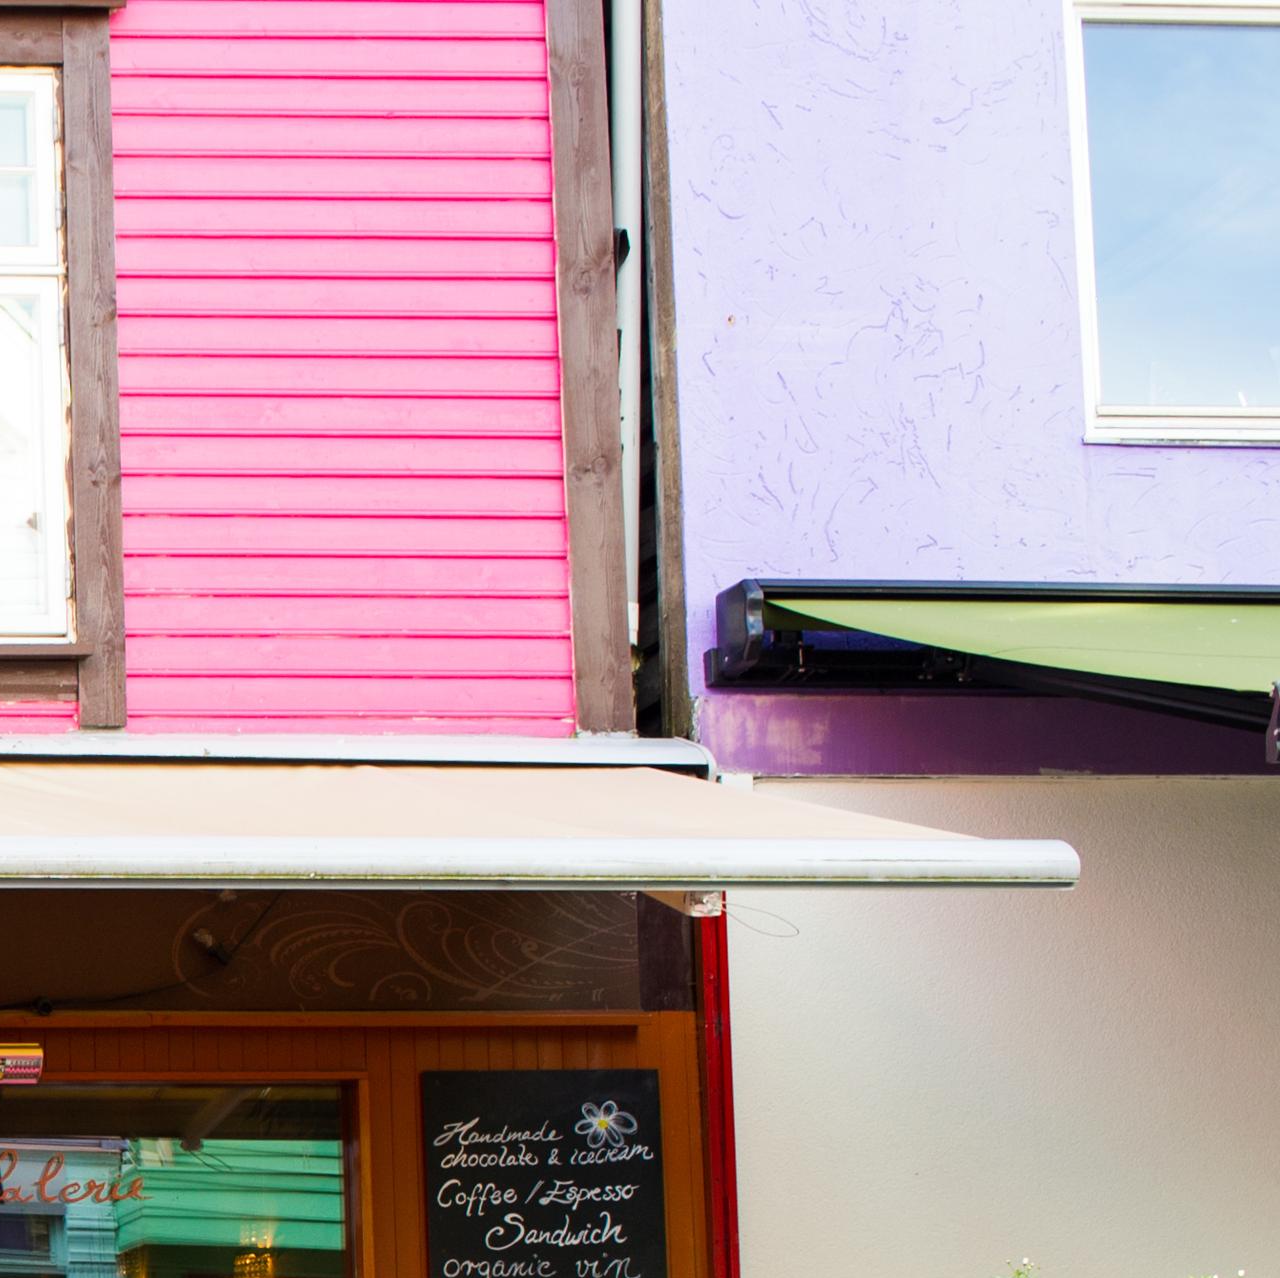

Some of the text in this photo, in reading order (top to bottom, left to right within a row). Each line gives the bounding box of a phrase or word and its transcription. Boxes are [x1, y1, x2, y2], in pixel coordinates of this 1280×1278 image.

[433, 1116, 564, 1147] Handmade
[440, 1143, 654, 1169] chocolate & icecream
[437, 1178, 517, 1217] Coffee
[538, 1179, 640, 1211] Espresso
[485, 1211, 627, 1251] Sandwich
